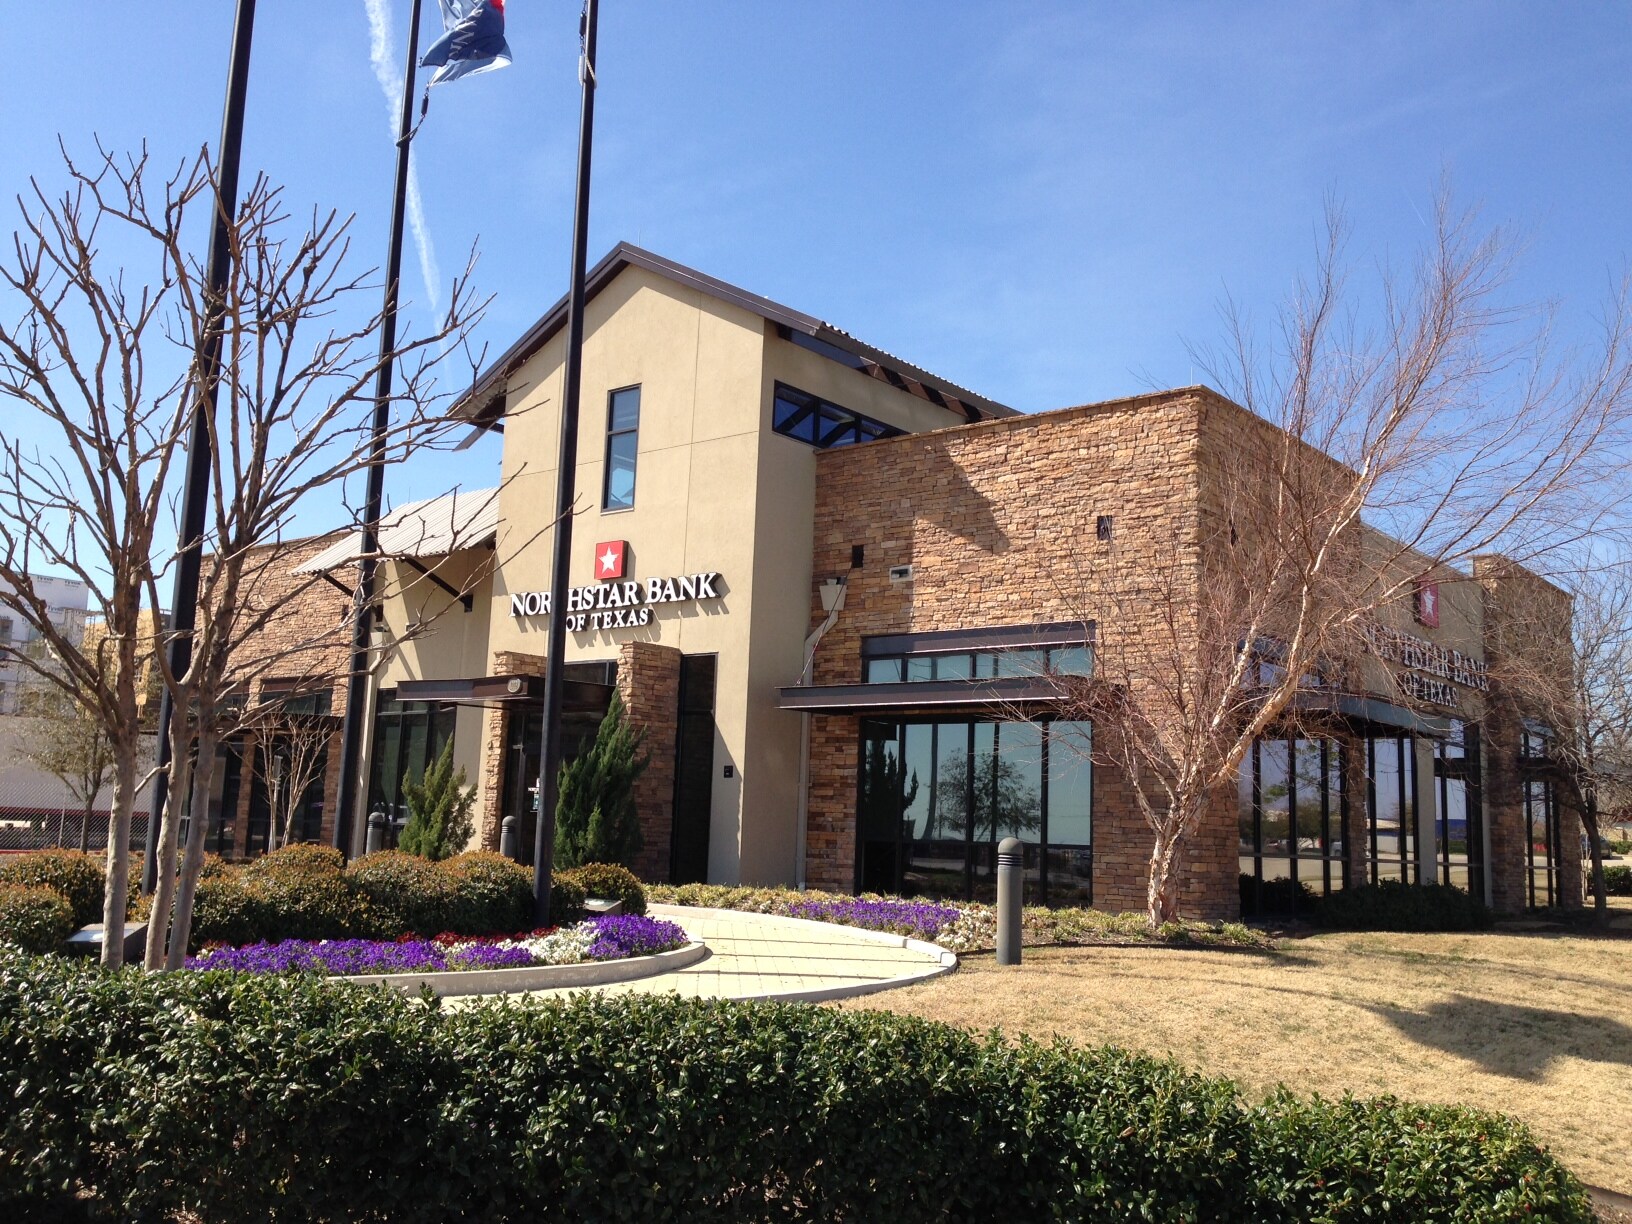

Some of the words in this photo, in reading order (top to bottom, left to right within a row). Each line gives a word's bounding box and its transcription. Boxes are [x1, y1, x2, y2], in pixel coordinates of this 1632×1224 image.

[509, 581, 639, 617] NORHSTAR
[645, 572, 720, 604] BANK
[566, 613, 586, 633] OF
[591, 608, 649, 631] TEXAS
